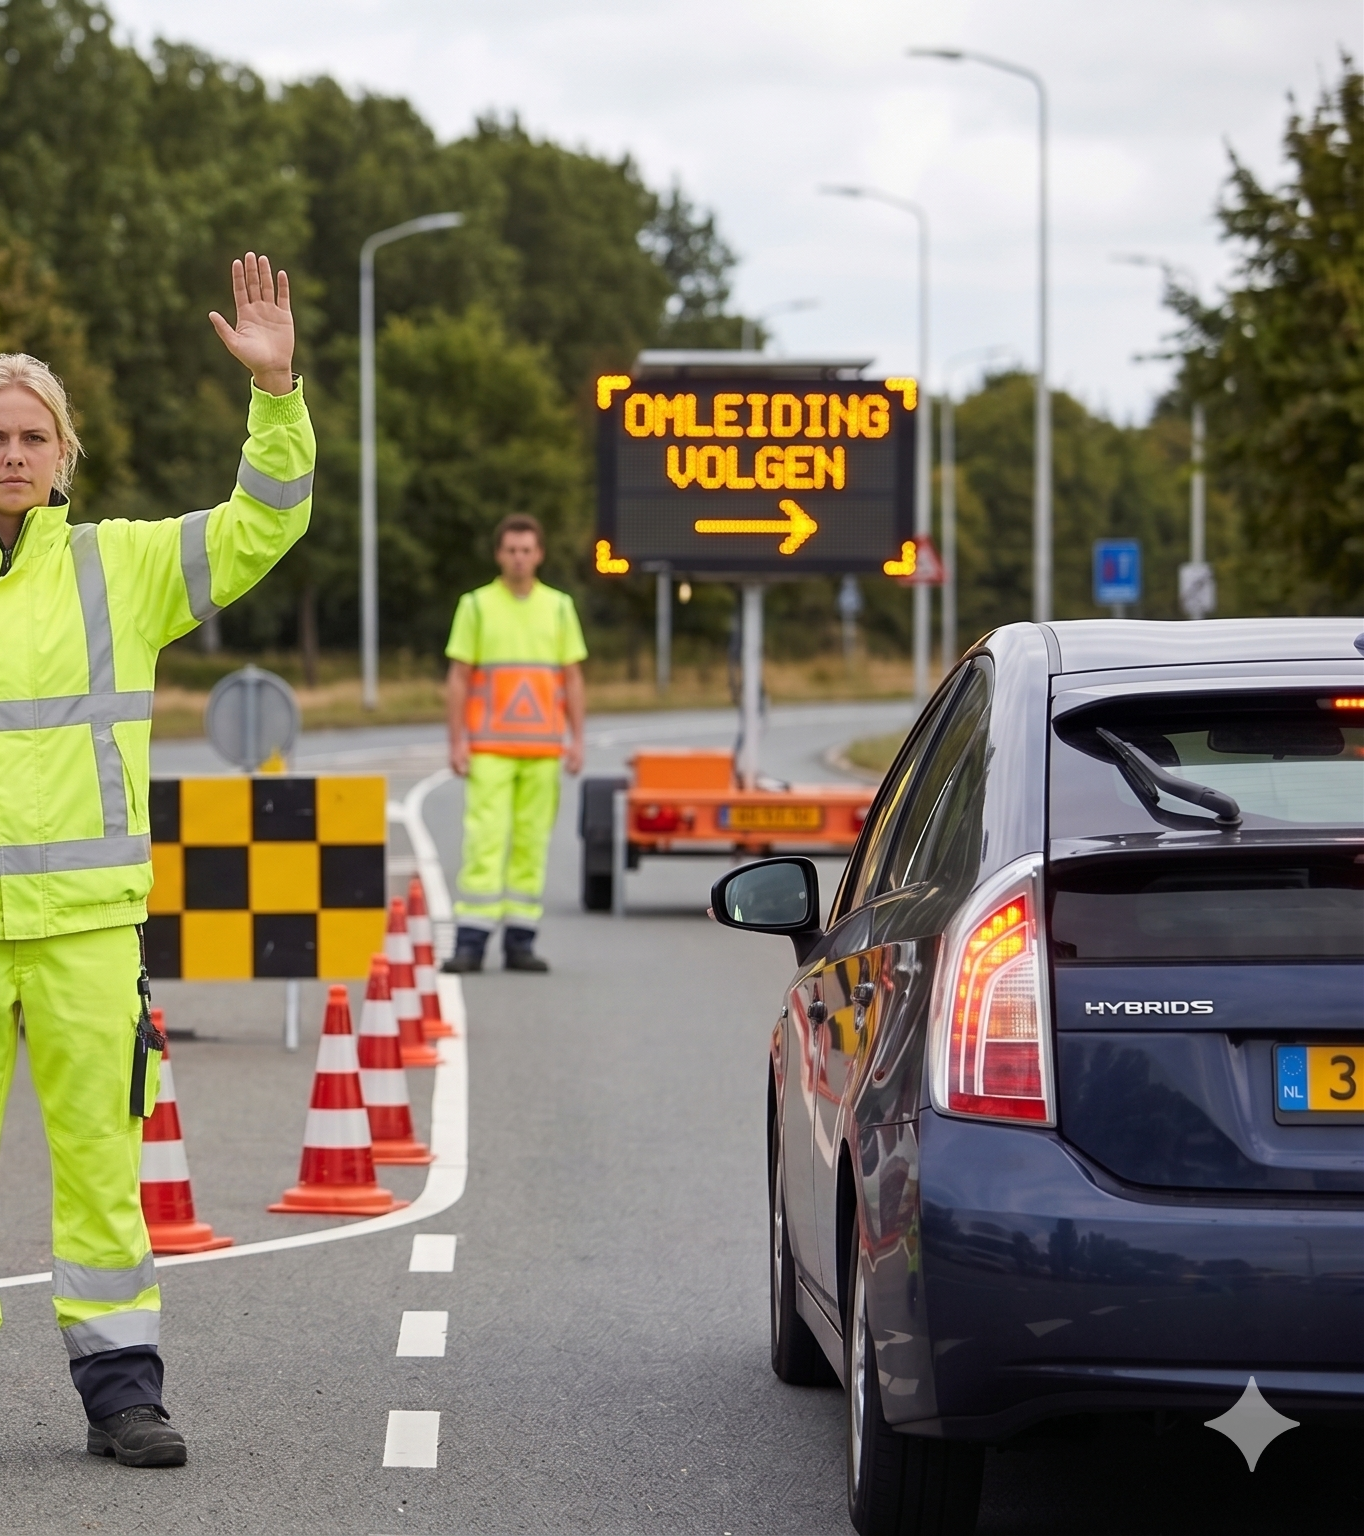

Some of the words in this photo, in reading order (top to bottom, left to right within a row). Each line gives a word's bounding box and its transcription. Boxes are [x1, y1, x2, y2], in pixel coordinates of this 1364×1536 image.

[624, 393, 890, 438] OMLEIDING
[666, 445, 846, 490] VOLGEN
[1085, 1000, 1214, 1015] HYBRIDS
[1284, 1086, 1304, 1098] NL
[1329, 1054, 1357, 1101] 3
